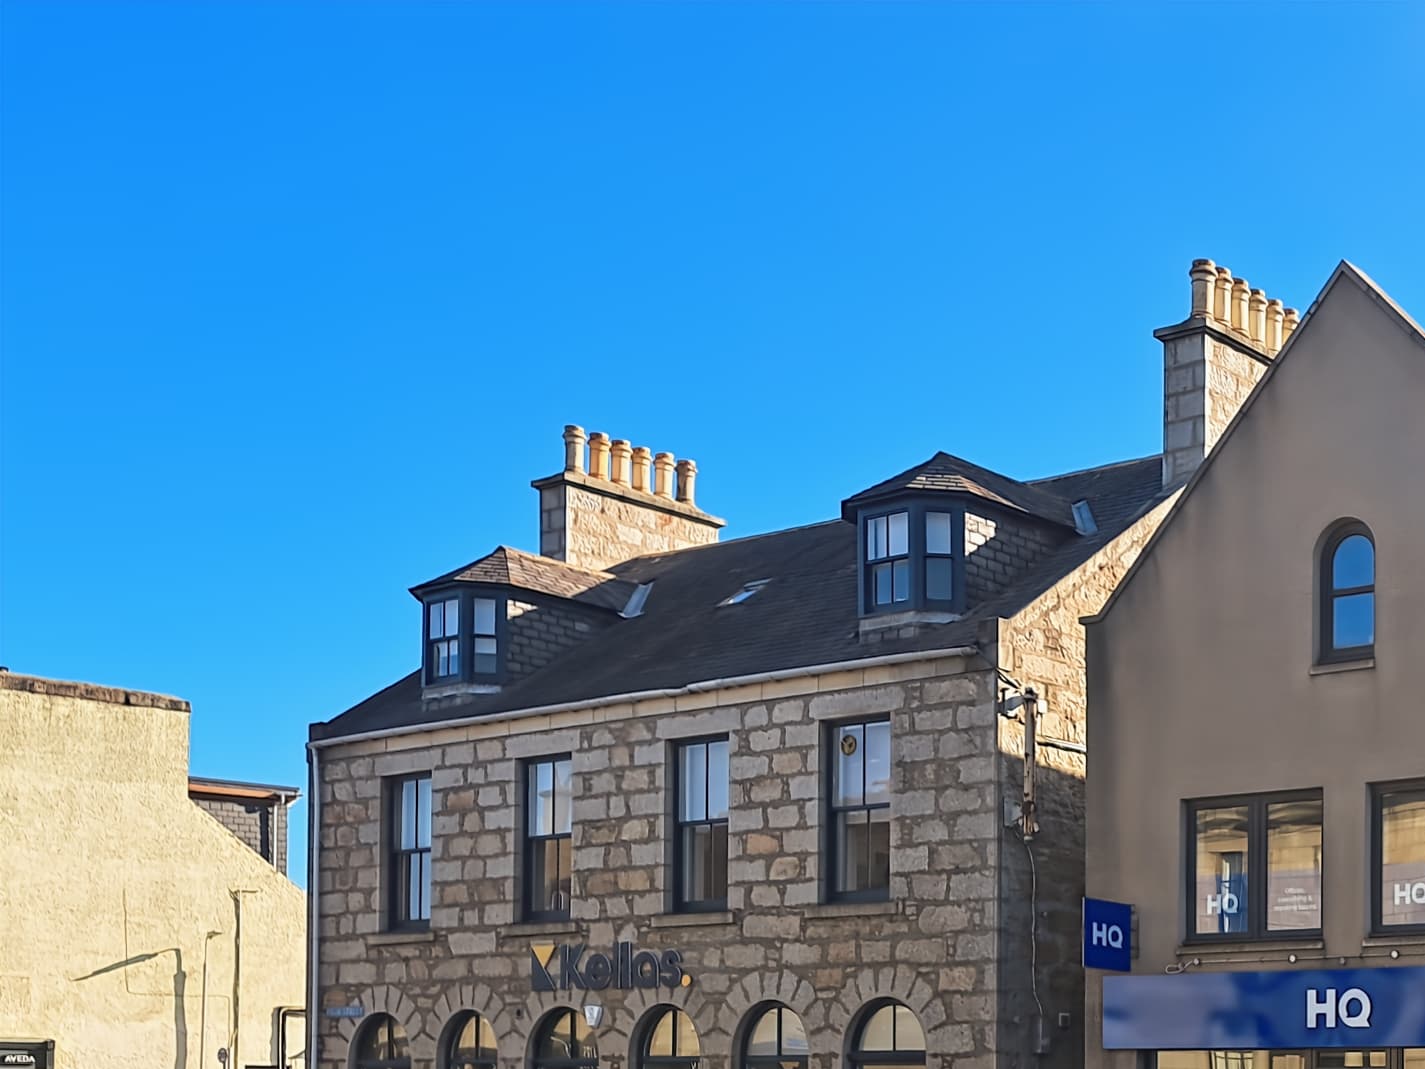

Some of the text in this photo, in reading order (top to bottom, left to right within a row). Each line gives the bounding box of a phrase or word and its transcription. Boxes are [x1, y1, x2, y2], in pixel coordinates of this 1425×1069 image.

[1207, 893, 1239, 915] HQ
[1092, 921, 1123, 949] HQ
[1306, 988, 1371, 1028] HQ
[4, 1054, 36, 1063] AVEDA
